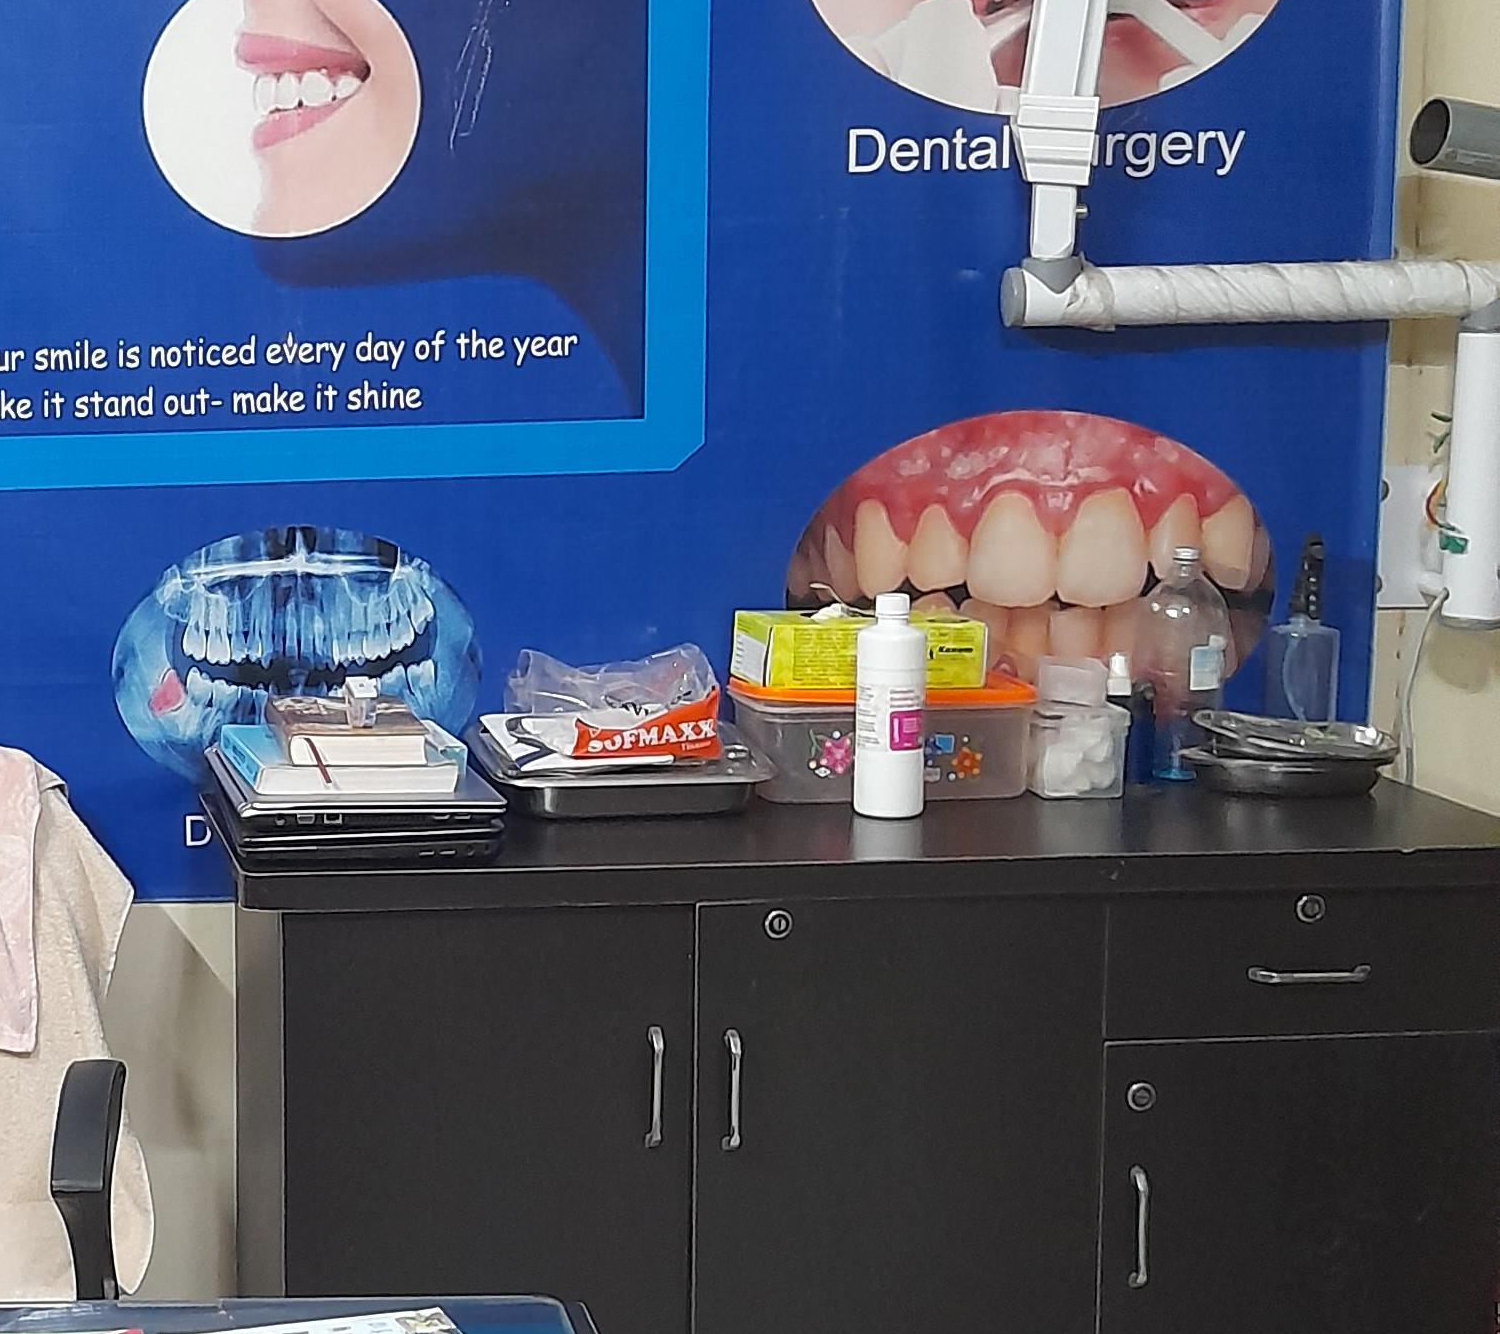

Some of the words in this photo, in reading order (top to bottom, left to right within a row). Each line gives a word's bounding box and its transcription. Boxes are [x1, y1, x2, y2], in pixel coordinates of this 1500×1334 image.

[848, 124, 1010, 173] Dental
[1093, 130, 1246, 178] rgery
[34, 339, 108, 371] smile
[118, 340, 140, 369] is
[150, 335, 256, 369] noticed
[266, 337, 346, 371] every
[355, 331, 405, 369] day
[414, 329, 446, 362] of
[455, 328, 505, 360] the
[513, 335, 578, 365] year
[43, 389, 65, 419] it
[74, 386, 154, 418] stand
[163, 388, 222, 416] out-
[233, 382, 306, 415] make
[316, 383, 338, 412] it
[347, 380, 422, 411] shine
